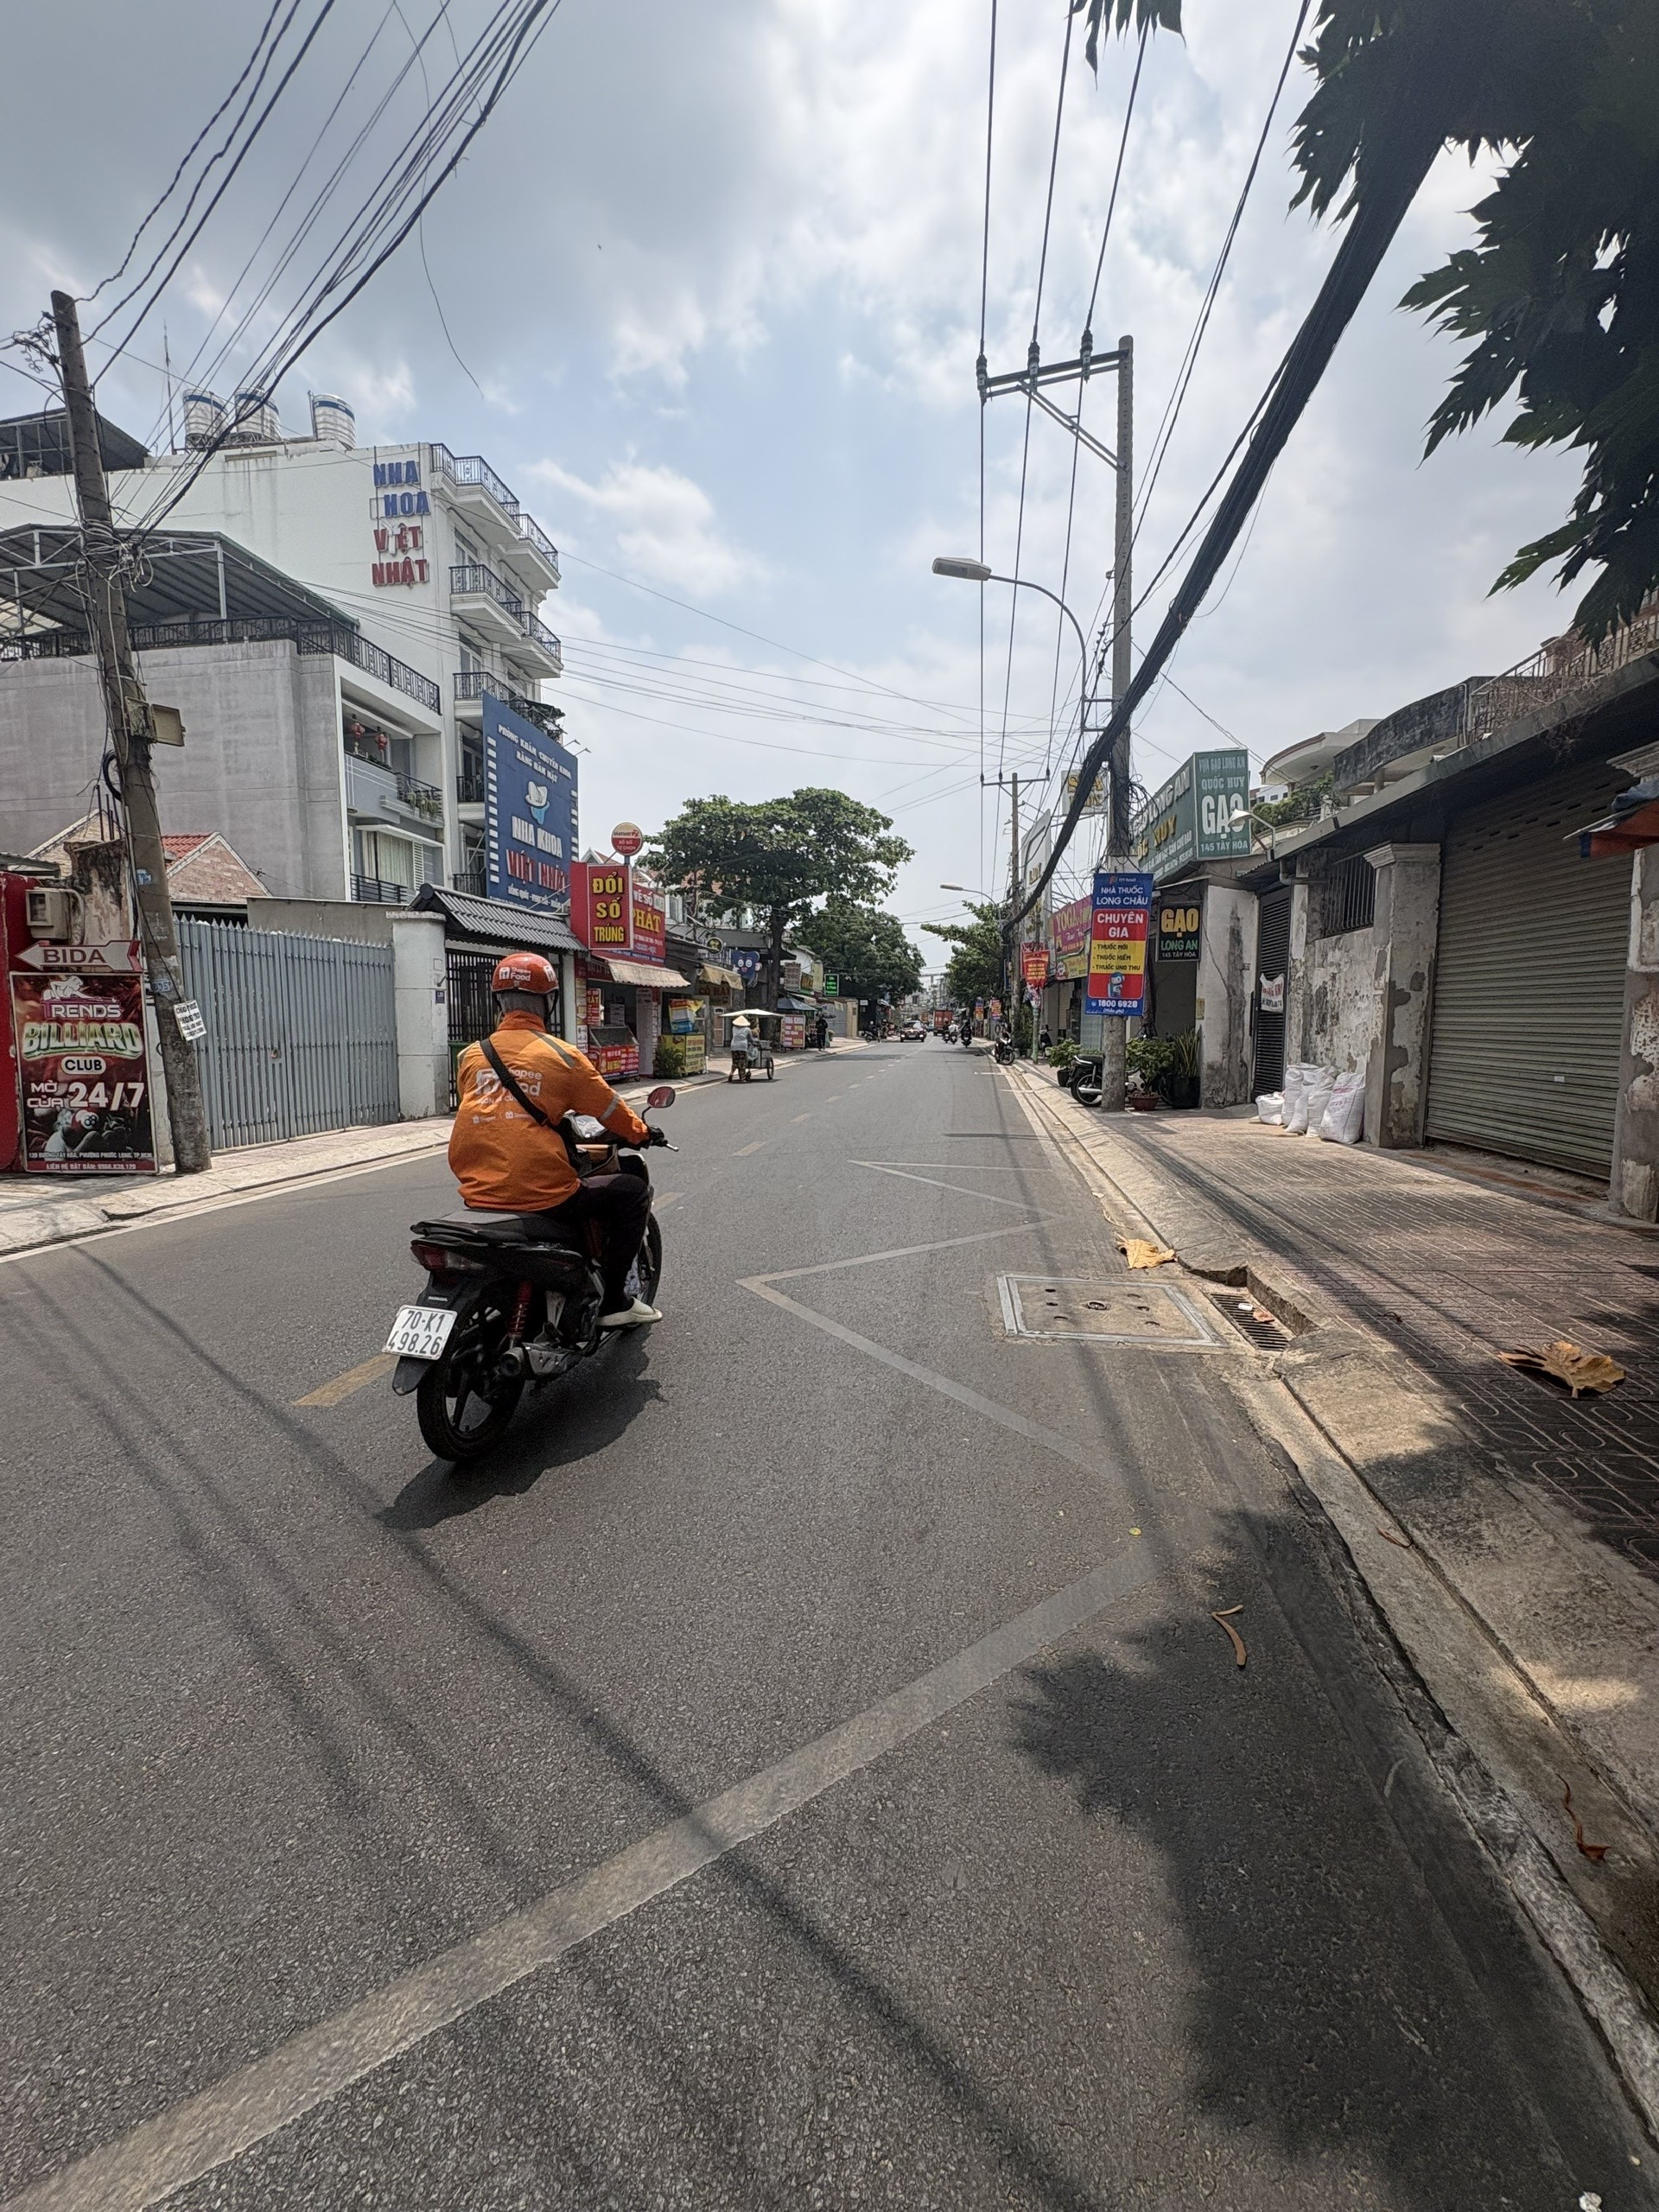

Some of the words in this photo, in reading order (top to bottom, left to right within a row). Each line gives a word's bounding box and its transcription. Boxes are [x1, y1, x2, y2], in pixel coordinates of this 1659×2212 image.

[373, 461, 420, 486] NHA
[384, 491, 431, 517] HOA
[372, 556, 429, 588] NHẬT
[498, 724, 519, 744] PHÒNG
[1068, 775, 1103, 793] SA
[1173, 766, 1191, 802] AN
[1201, 774, 1224, 791] QUỐC
[1227, 776, 1245, 788] HUY
[1201, 792, 1244, 839] GẠO
[512, 816, 536, 847] NHA
[537, 827, 563, 858] KHOA
[1200, 842, 1215, 852] 145
[1216, 841, 1230, 852] TÂY
[1232, 839, 1248, 850] HÒA
[505, 849, 535, 885] VIỆT
[592, 871, 624, 894] ĐỔI
[1101, 886, 1116, 894] NHÀ
[1118, 885, 1144, 894] THUỐC
[596, 896, 622, 919] SỐ
[643, 891, 653, 906] SỐ
[1096, 896, 1122, 906] LONG
[1122, 893, 1148, 906] CHÂU
[1097, 911, 1144, 924] CHUYÊN
[1161, 907, 1198, 938] GẠO
[594, 923, 625, 943] TRÚNG
[1109, 926, 1129, 938] GIA
[1161, 940, 1184, 950] LONG
[1185, 939, 1198, 950] AN
[44, 949, 107, 963] BIDA
[510, 972, 531, 982] Food
[511, 966, 531, 975] Shopee
[41, 998, 122, 1019] TRENDS
[1097, 999, 1116, 1007] 1800
[22, 1021, 143, 1060] BILLIARD
[65, 1058, 103, 1071] CLUB
[68, 1082, 144, 1111] 24/7
[402, 1310, 446, 1332] 70-K1
[387, 1331, 442, 1356] 498.26
